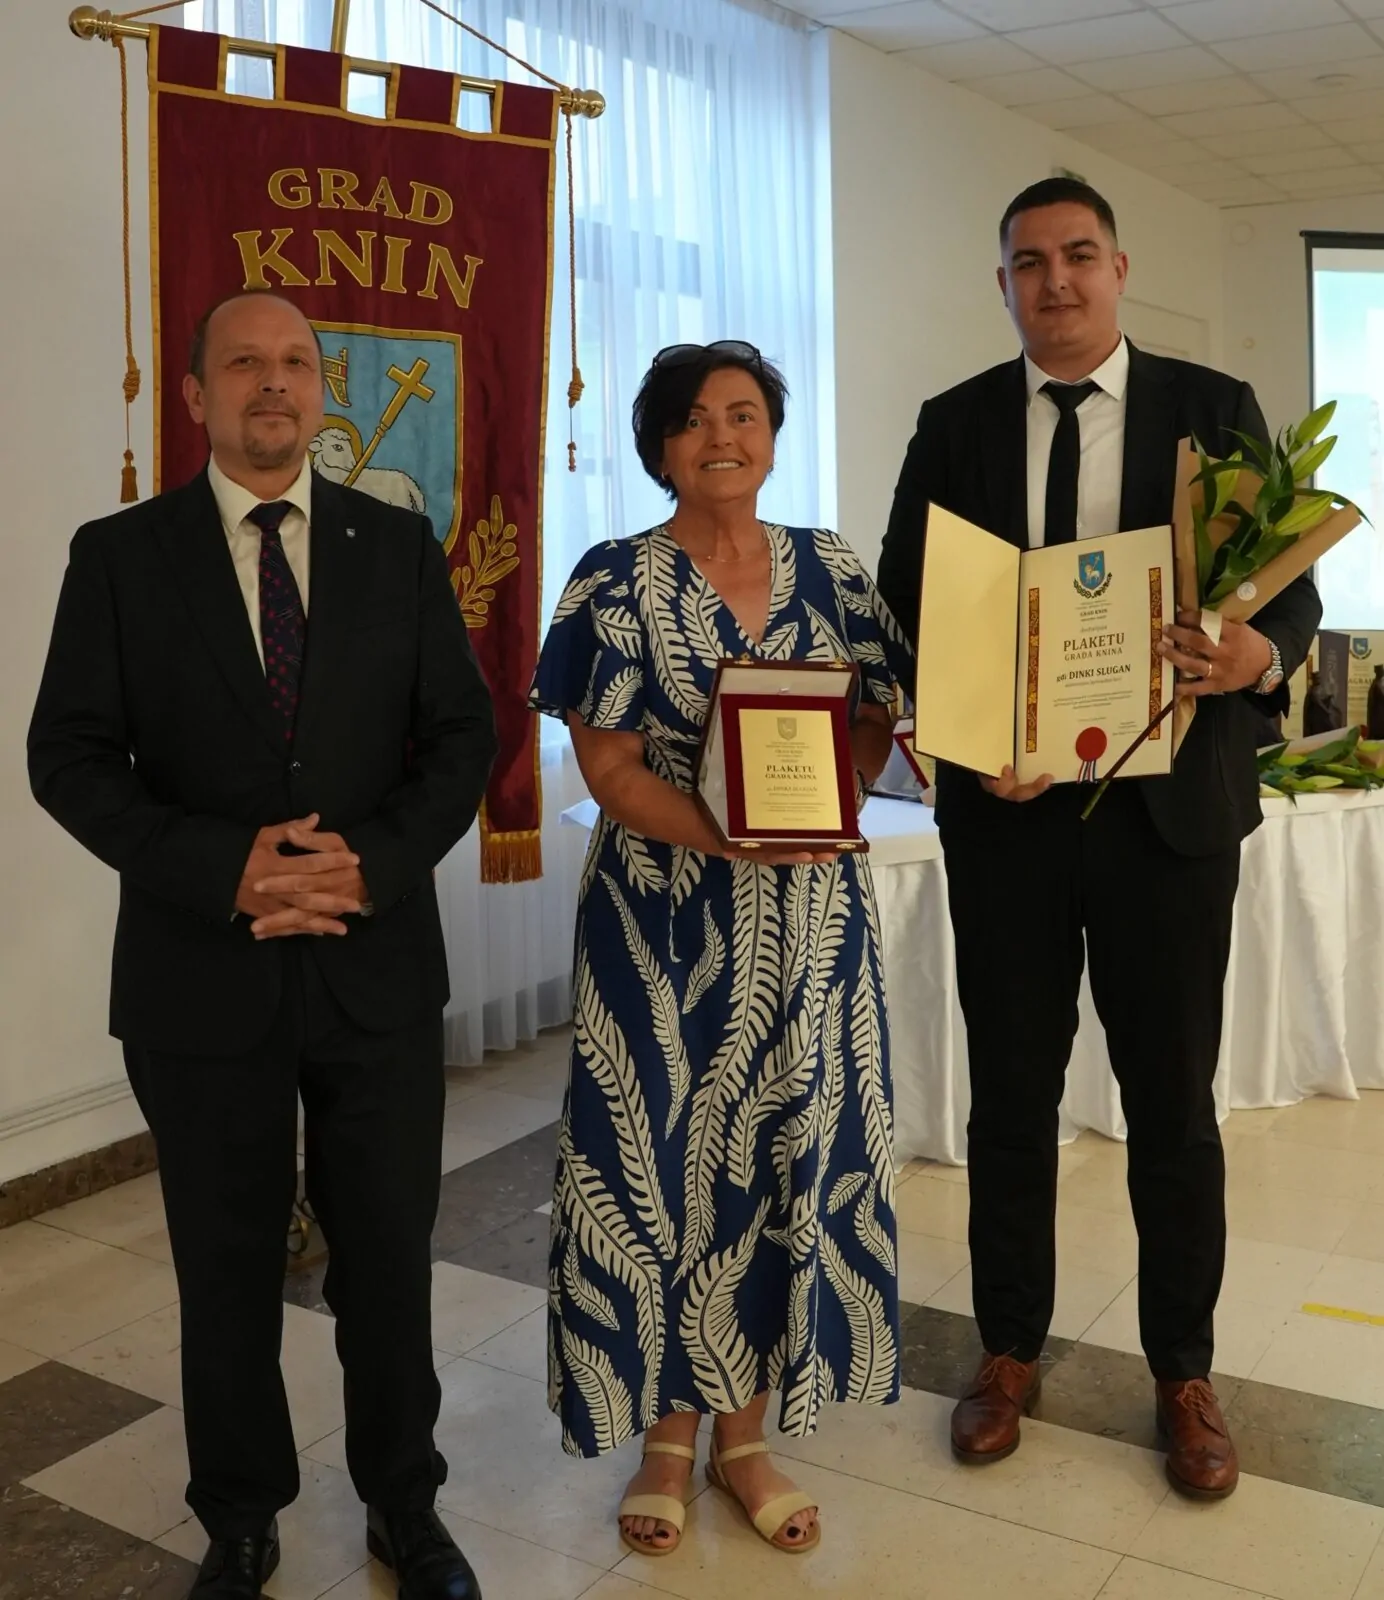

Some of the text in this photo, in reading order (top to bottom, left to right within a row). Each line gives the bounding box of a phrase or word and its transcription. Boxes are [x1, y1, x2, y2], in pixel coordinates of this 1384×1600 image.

[268, 168, 453, 225] GRAD
[233, 228, 483, 308] KNIN
[1063, 632, 1125, 651] PLAKETU
[1064, 647, 1123, 661] GRADA KNINA
[1069, 669, 1094, 680] DINKI
[1096, 664, 1131, 676] SLUGAN
